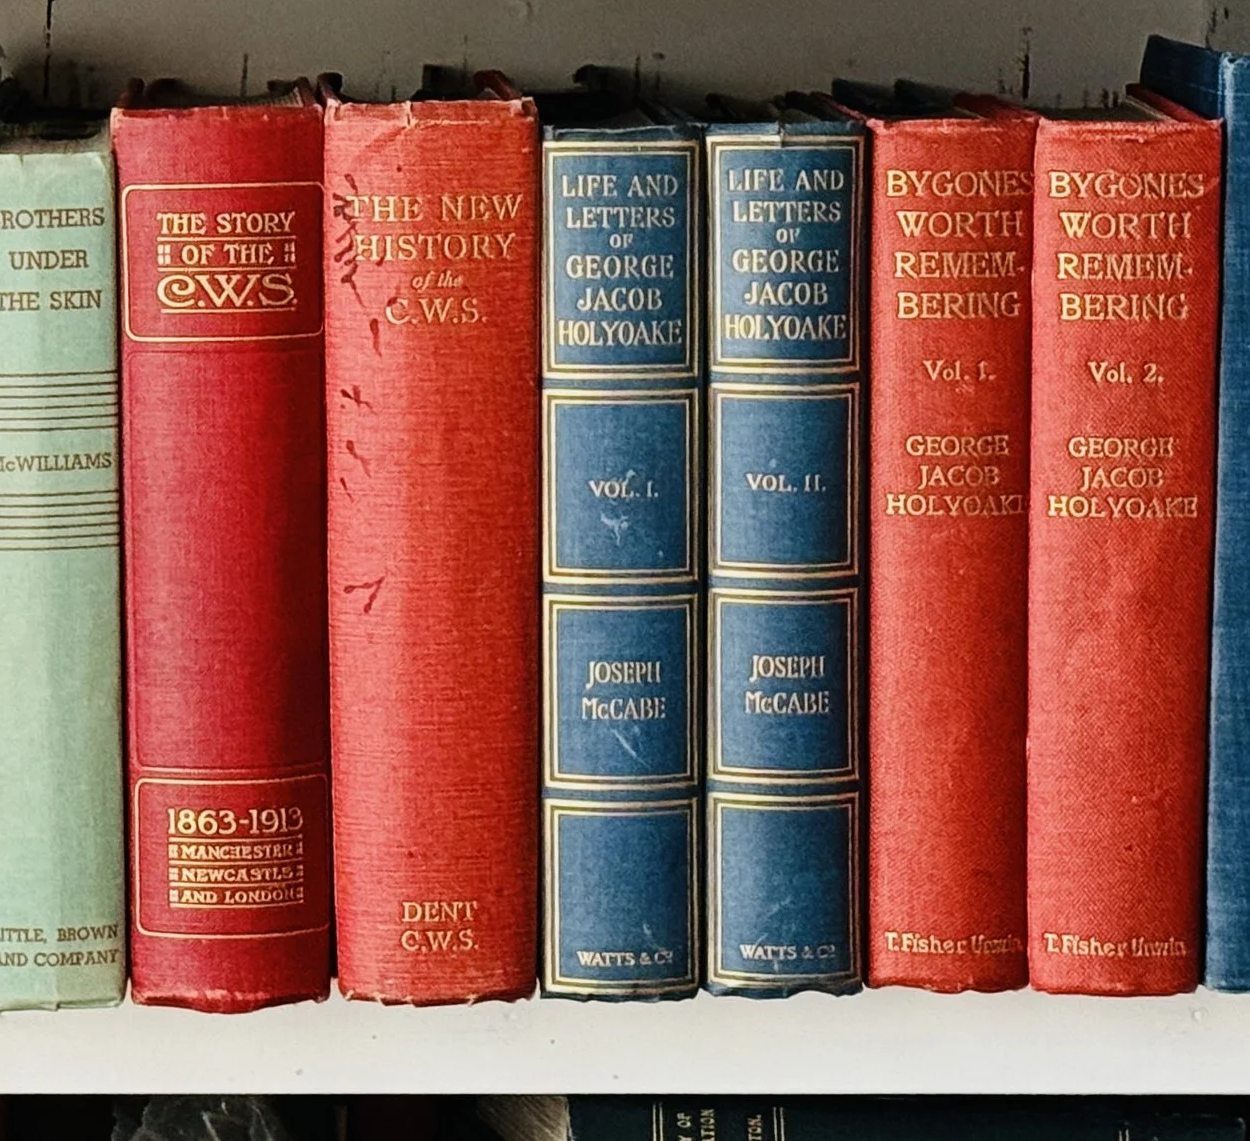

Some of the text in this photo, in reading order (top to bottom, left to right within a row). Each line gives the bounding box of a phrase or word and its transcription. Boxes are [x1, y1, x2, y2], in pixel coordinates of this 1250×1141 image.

[561, 174, 679, 200] LIFE AND
[728, 168, 845, 193] LIFE AND
[886, 170, 1034, 199] BYGONES
[1049, 170, 1205, 200] BYGONES
[346, 193, 523, 222] THE NEW
[565, 206, 676, 231] LETTERS
[732, 200, 842, 224] LETTERS
[156, 210, 296, 235] THE STORY
[896, 210, 1023, 238] WORTH
[1059, 211, 1192, 241] WORTH
[355, 232, 517, 261] HISTORY
[609, 233, 634, 249] OF
[775, 227, 801, 244] OF
[9, 249, 89, 271] UNDER
[181, 243, 275, 266] OF THE
[732, 249, 840, 274] GEORGE
[565, 255, 675, 281] GEORGE
[412, 270, 433, 291] of
[50, 289, 102, 310] SKIN
[576, 287, 663, 313] JACOB
[744, 281, 829, 307] JACOB
[897, 291, 1021, 321] BERING
[1059, 293, 1189, 322] BERING
[558, 319, 684, 348] HOLYOAKE
[725, 315, 847, 341] HOLYOAKE
[1088, 361, 1133, 384] Vol.
[905, 435, 1010, 456] GEORGE
[1068, 436, 1174, 461] GEORGE
[588, 479, 640, 500] VOL.
[746, 473, 798, 494] VOL.
[918, 465, 1000, 491] JACOB
[1080, 467, 1165, 493] JACOB
[1047, 496, 1198, 520] HOLYOAKE
[586, 661, 662, 688] JOSEPH
[749, 655, 826, 682] JOSEPH
[581, 697, 667, 721] McCABE
[744, 691, 830, 715] McCABE
[167, 806, 304, 836] 1863-1913
[181, 840, 295, 860] MANCHESTER
[181, 866, 293, 883] NEWCASTLE
[181, 887, 295, 905] AND LONDON
[401, 900, 479, 924] DENT
[56, 923, 119, 942] BROWN
[400, 930, 478, 952] C.W.S.
[33, 948, 119, 967] COMPANY
[576, 950, 635, 968] WATTS
[738, 943, 797, 961] WATTS
[677, 1113, 692, 1128] OF
